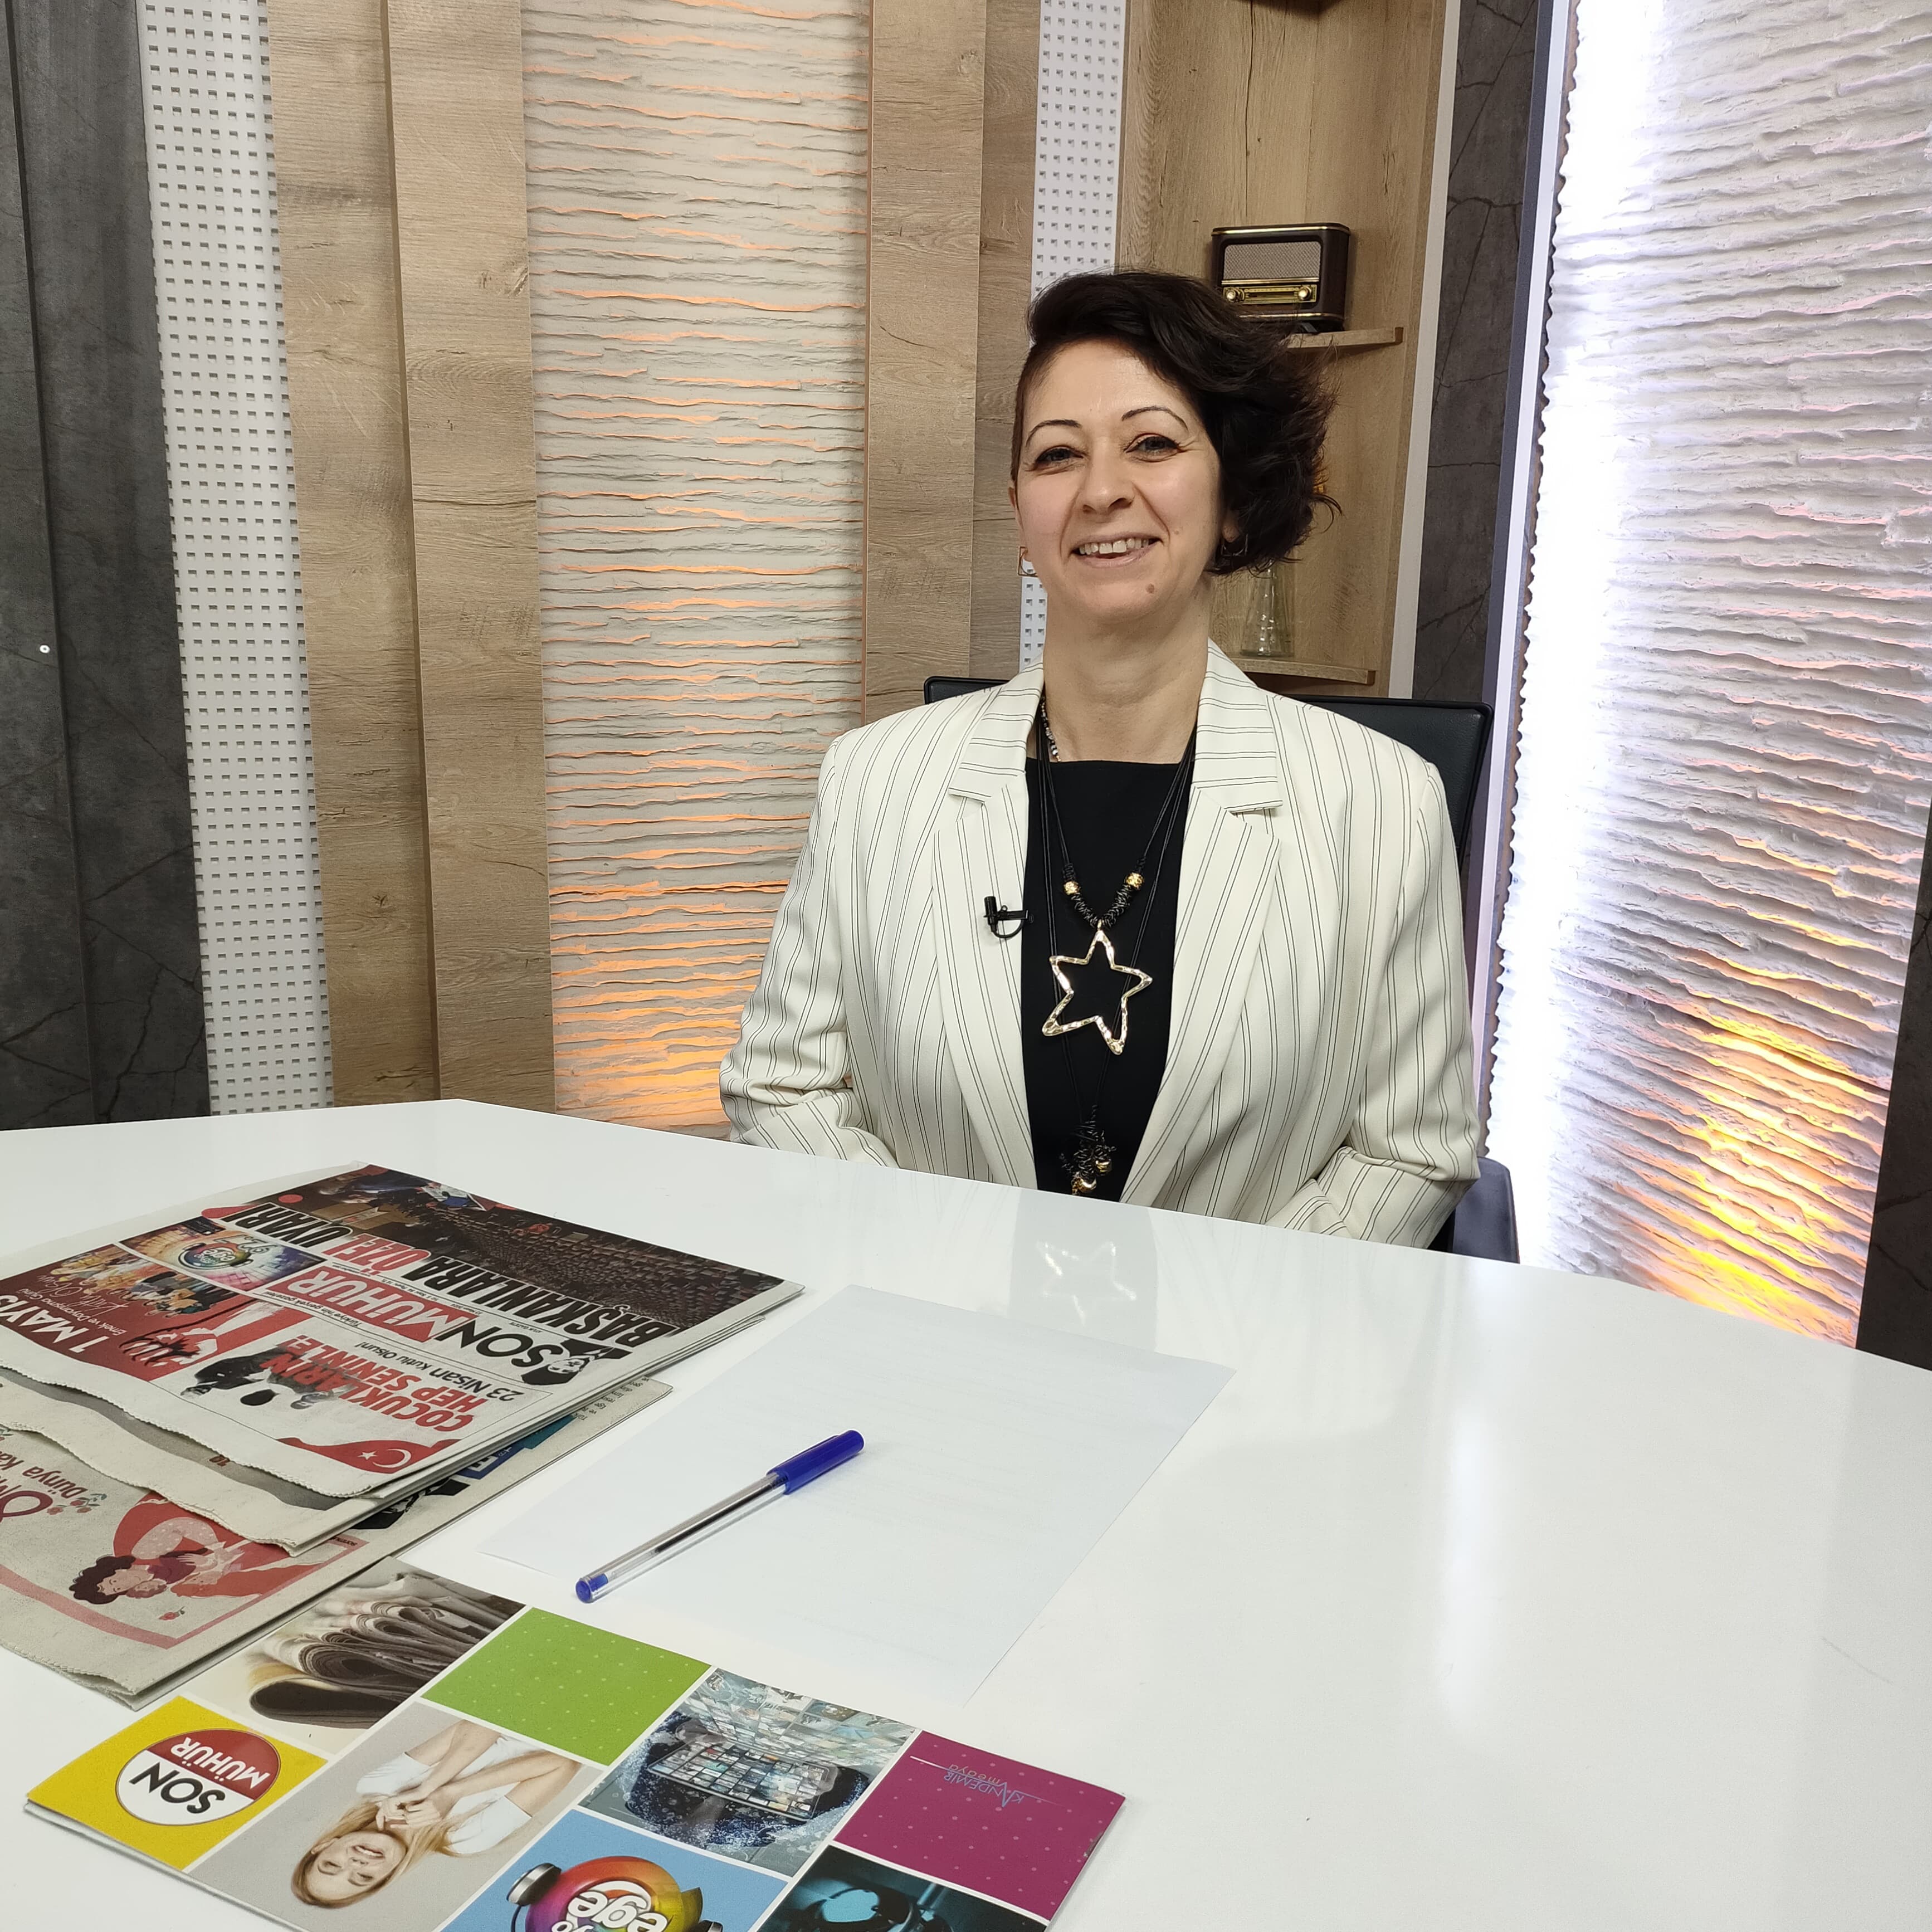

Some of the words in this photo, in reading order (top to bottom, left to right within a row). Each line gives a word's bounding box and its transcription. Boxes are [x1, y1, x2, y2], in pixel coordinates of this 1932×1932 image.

[219, 1203, 353, 1249] UYARI
[321, 1233, 431, 1276] ÖZEL
[287, 1271, 469, 1339] MÜHÜR
[400, 1257, 680, 1348] BAŞKANLARA
[69, 1336, 109, 1353] 1
[97, 1323, 127, 1336] Emek
[432, 1320, 563, 1368] SON
[354, 1341, 397, 1359] Olsun!
[396, 1355, 432, 1370] Kutlu
[429, 1368, 492, 1393] Nisan
[486, 1388, 524, 1401] 23
[411, 1386, 489, 1413] HEP
[22, 1466, 89, 1499] Dünya
[171, 1737, 271, 1789] MÜHÜR
[129, 1762, 226, 1814] SON
[567, 1891, 668, 1932] ege
